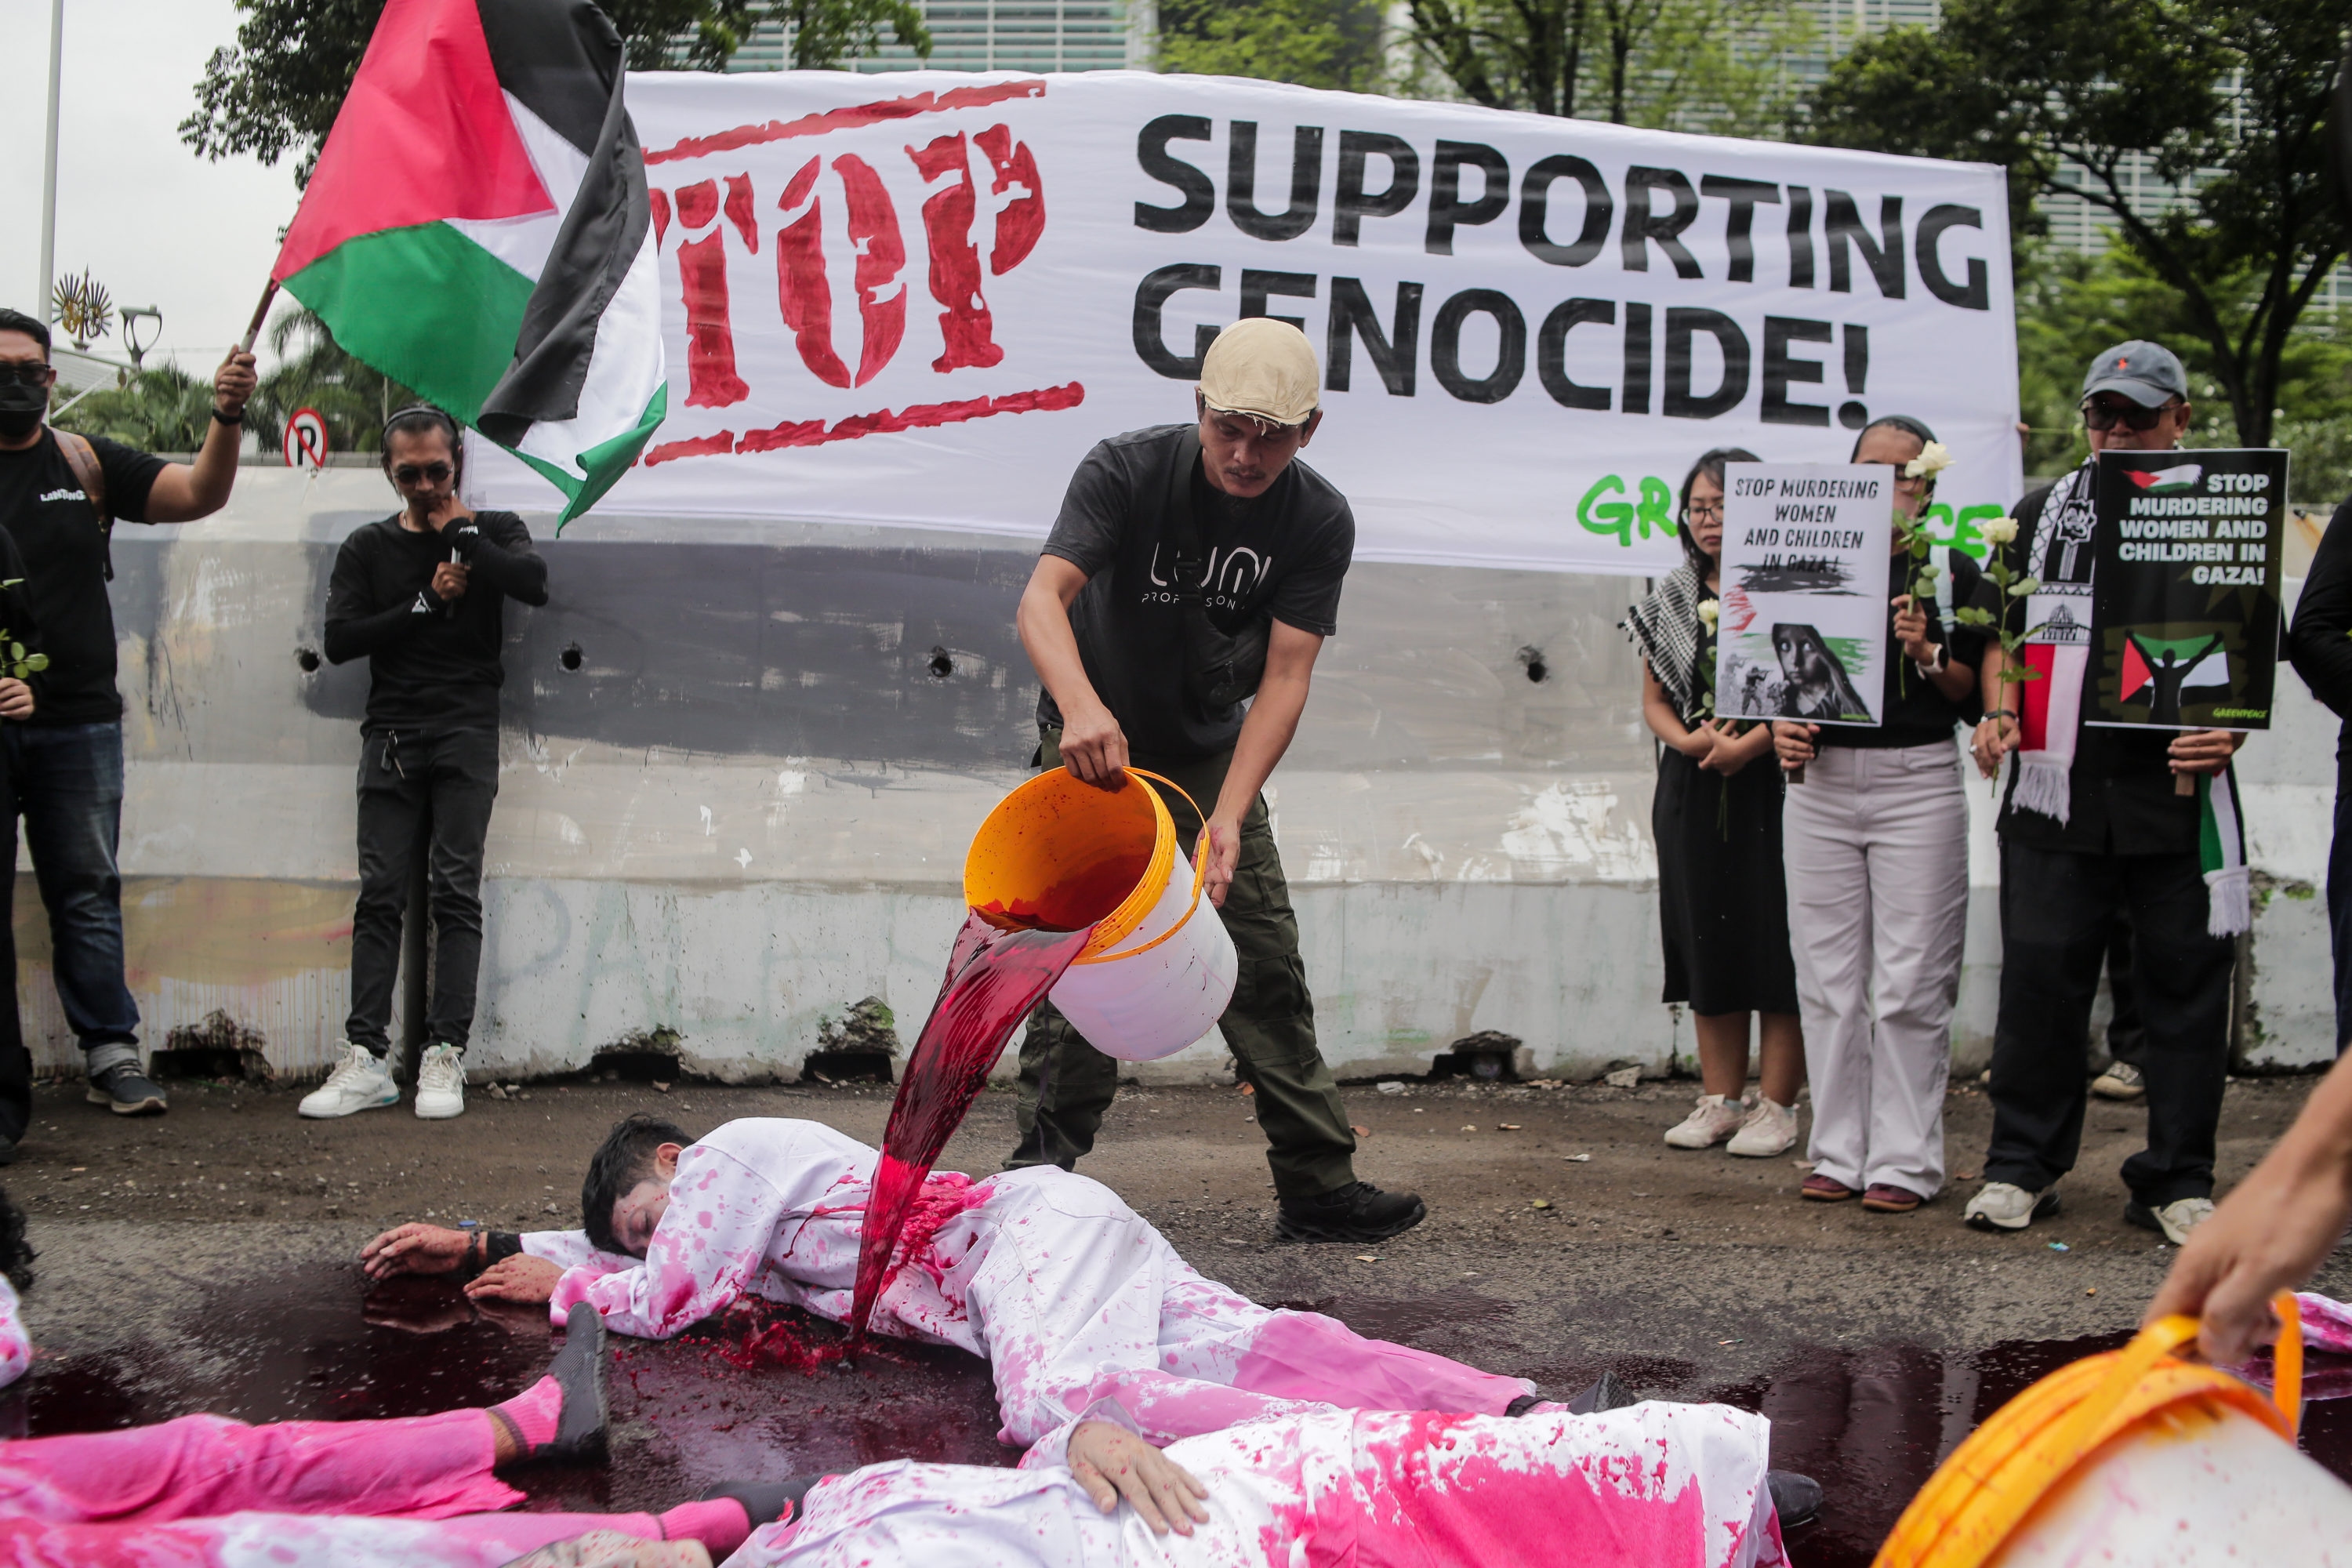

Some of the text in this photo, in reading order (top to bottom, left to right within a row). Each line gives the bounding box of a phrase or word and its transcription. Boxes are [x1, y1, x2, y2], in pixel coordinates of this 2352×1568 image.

[1134, 114, 1991, 310] SUPPORTING
[650, 123, 1047, 409] TOP
[1735, 478, 1878, 499] STOP MURDERING
[2207, 474, 2270, 493] STOP
[1775, 504, 1837, 523] WOMEN
[2130, 496, 2268, 517] MURDERING
[1744, 528, 1864, 550] AND CHILDREN
[2119, 520, 2267, 539] WOMEN AND
[2118, 542, 2266, 562] CHILDREN IN
[1762, 554, 1781, 572] IN
[2192, 565, 2265, 586] GAZA!
